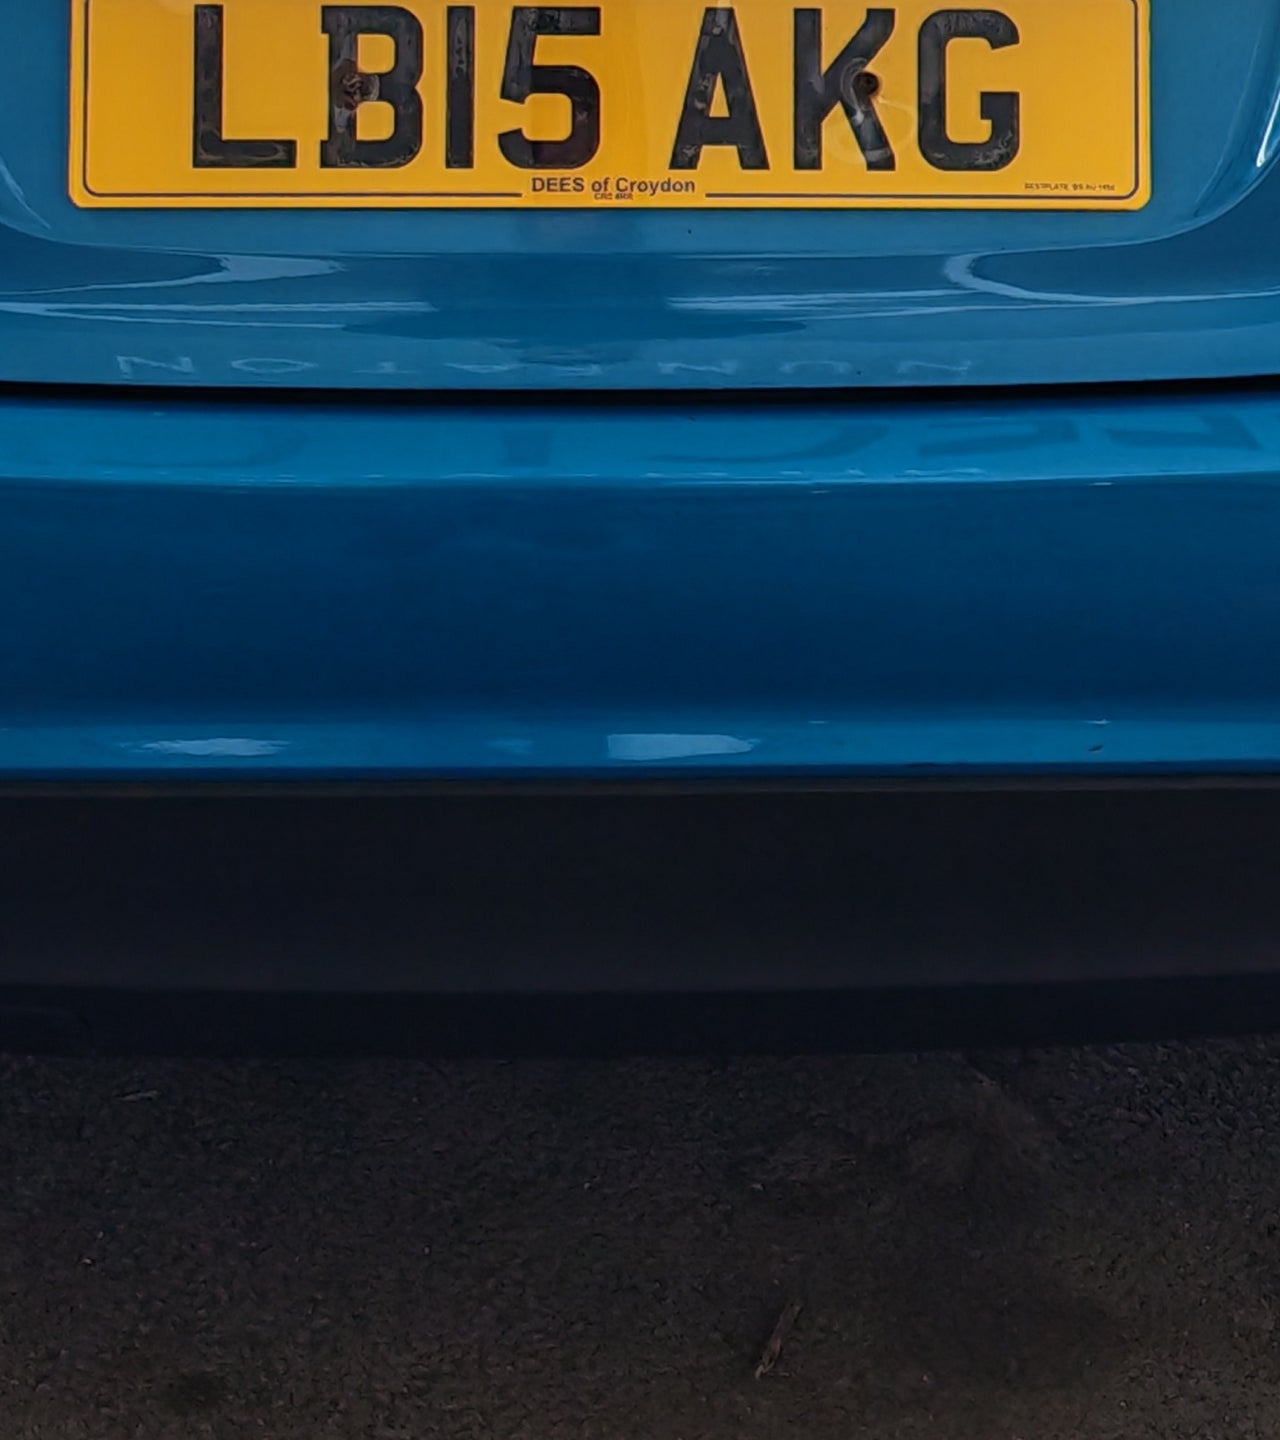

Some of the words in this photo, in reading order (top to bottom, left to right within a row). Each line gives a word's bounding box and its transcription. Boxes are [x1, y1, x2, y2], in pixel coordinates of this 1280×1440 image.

[193, 4, 601, 170] LB15
[668, 7, 1021, 171] AKG
[531, 177, 584, 192] DEES
[591, 177, 610, 192] of
[615, 177, 696, 196] Croydon
